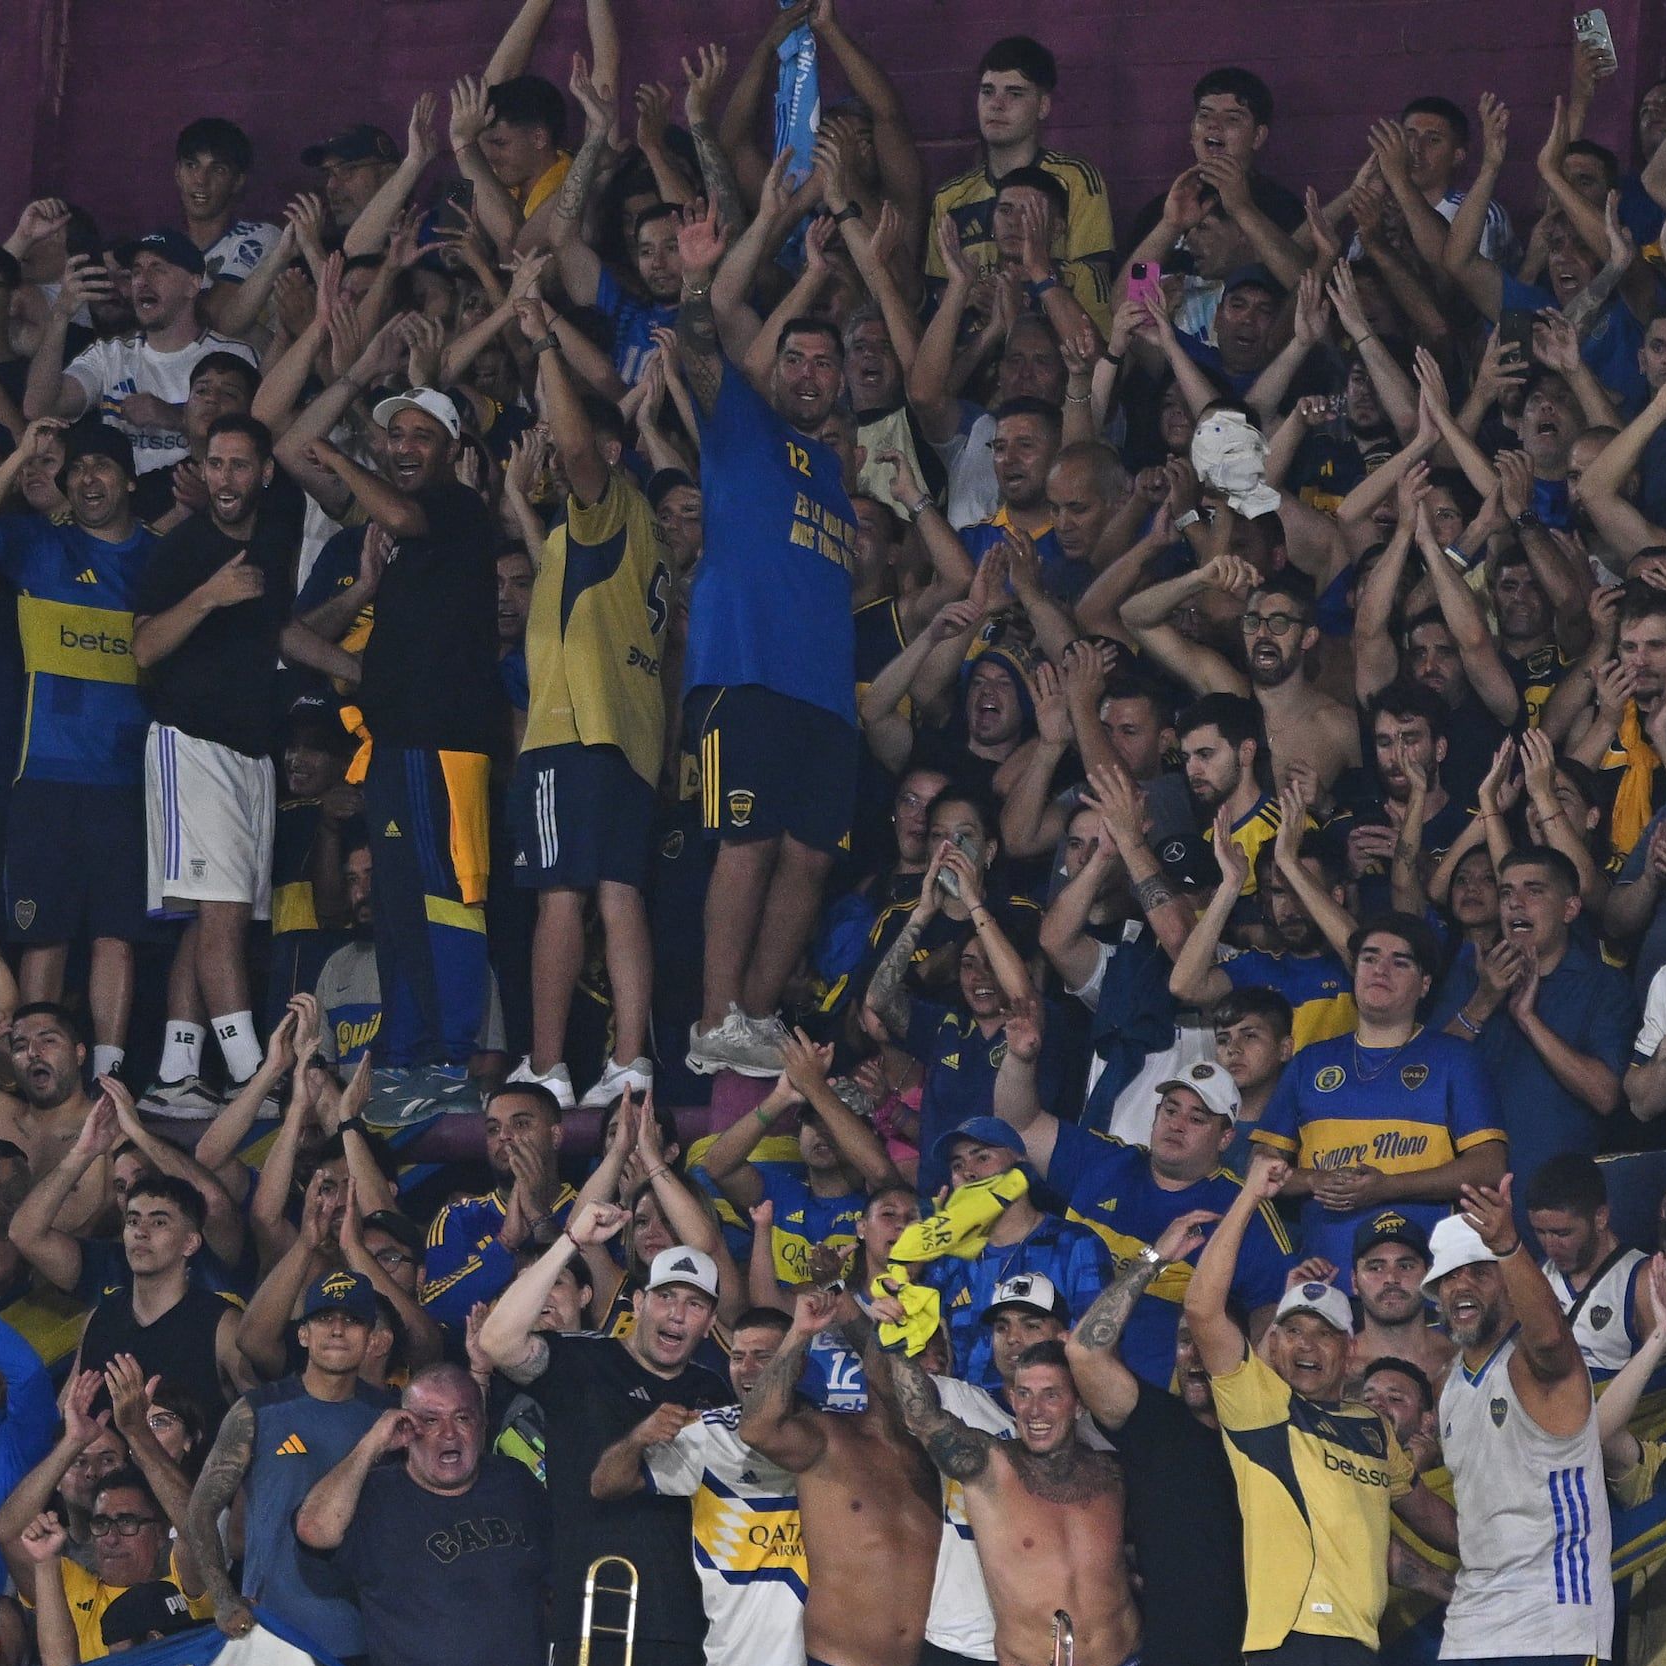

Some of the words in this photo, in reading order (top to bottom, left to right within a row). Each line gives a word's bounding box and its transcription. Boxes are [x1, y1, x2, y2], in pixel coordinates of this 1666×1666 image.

[786, 441, 811, 477] 12
[175, 1031, 195, 1044] 12
[219, 1025, 237, 1041] 12
[1372, 1130, 1429, 1161] Mono
[827, 1352, 863, 1390] 12
